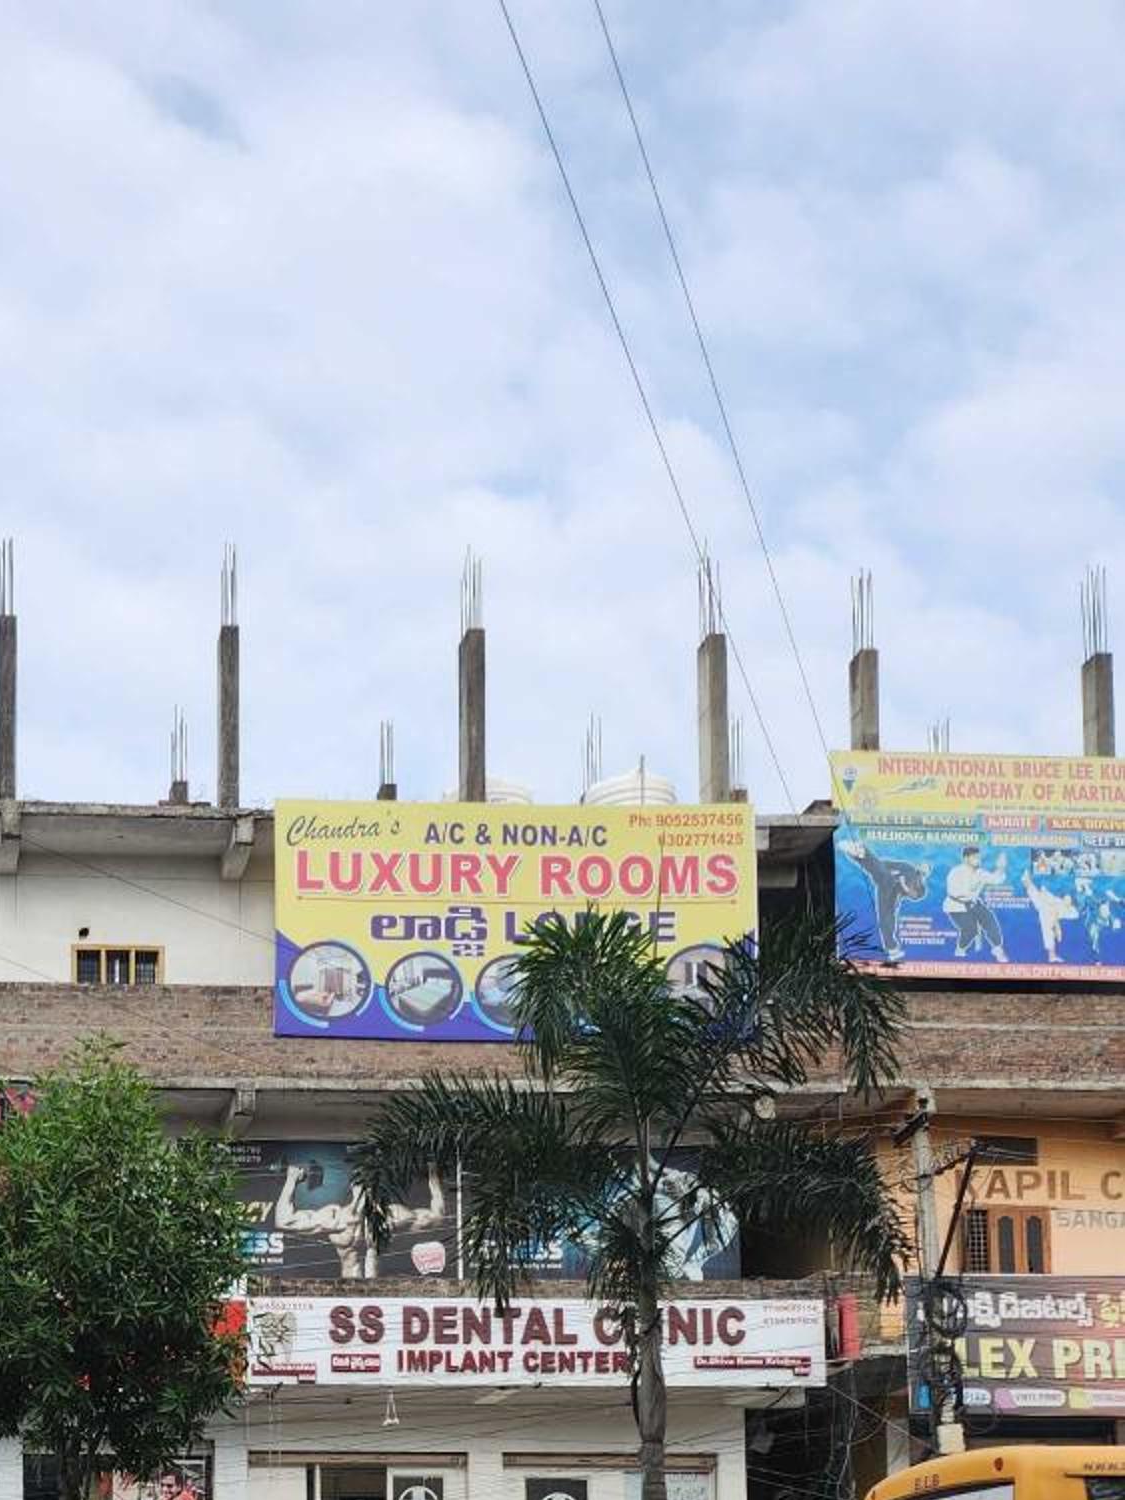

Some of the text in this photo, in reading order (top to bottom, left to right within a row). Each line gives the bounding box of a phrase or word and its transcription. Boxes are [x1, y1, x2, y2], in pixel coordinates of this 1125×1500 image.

[878, 759, 1005, 778] INTERNATIONAL
[1014, 763, 1061, 779] BRUCE
[1068, 764, 1094, 779] LEE
[945, 784, 1022, 800] ACADEMY
[1032, 785, 1055, 800] OF
[424, 822, 608, 847] A/C & NON-A/C
[296, 850, 740, 899] LUXURY ROOMS
[955, 1169, 1087, 1201] KAPIL
[329, 1305, 747, 1347] SS DENTAL CNIC
[397, 1350, 632, 1375] IMPLANT CENTER
[953, 1338, 1039, 1379] LEX
